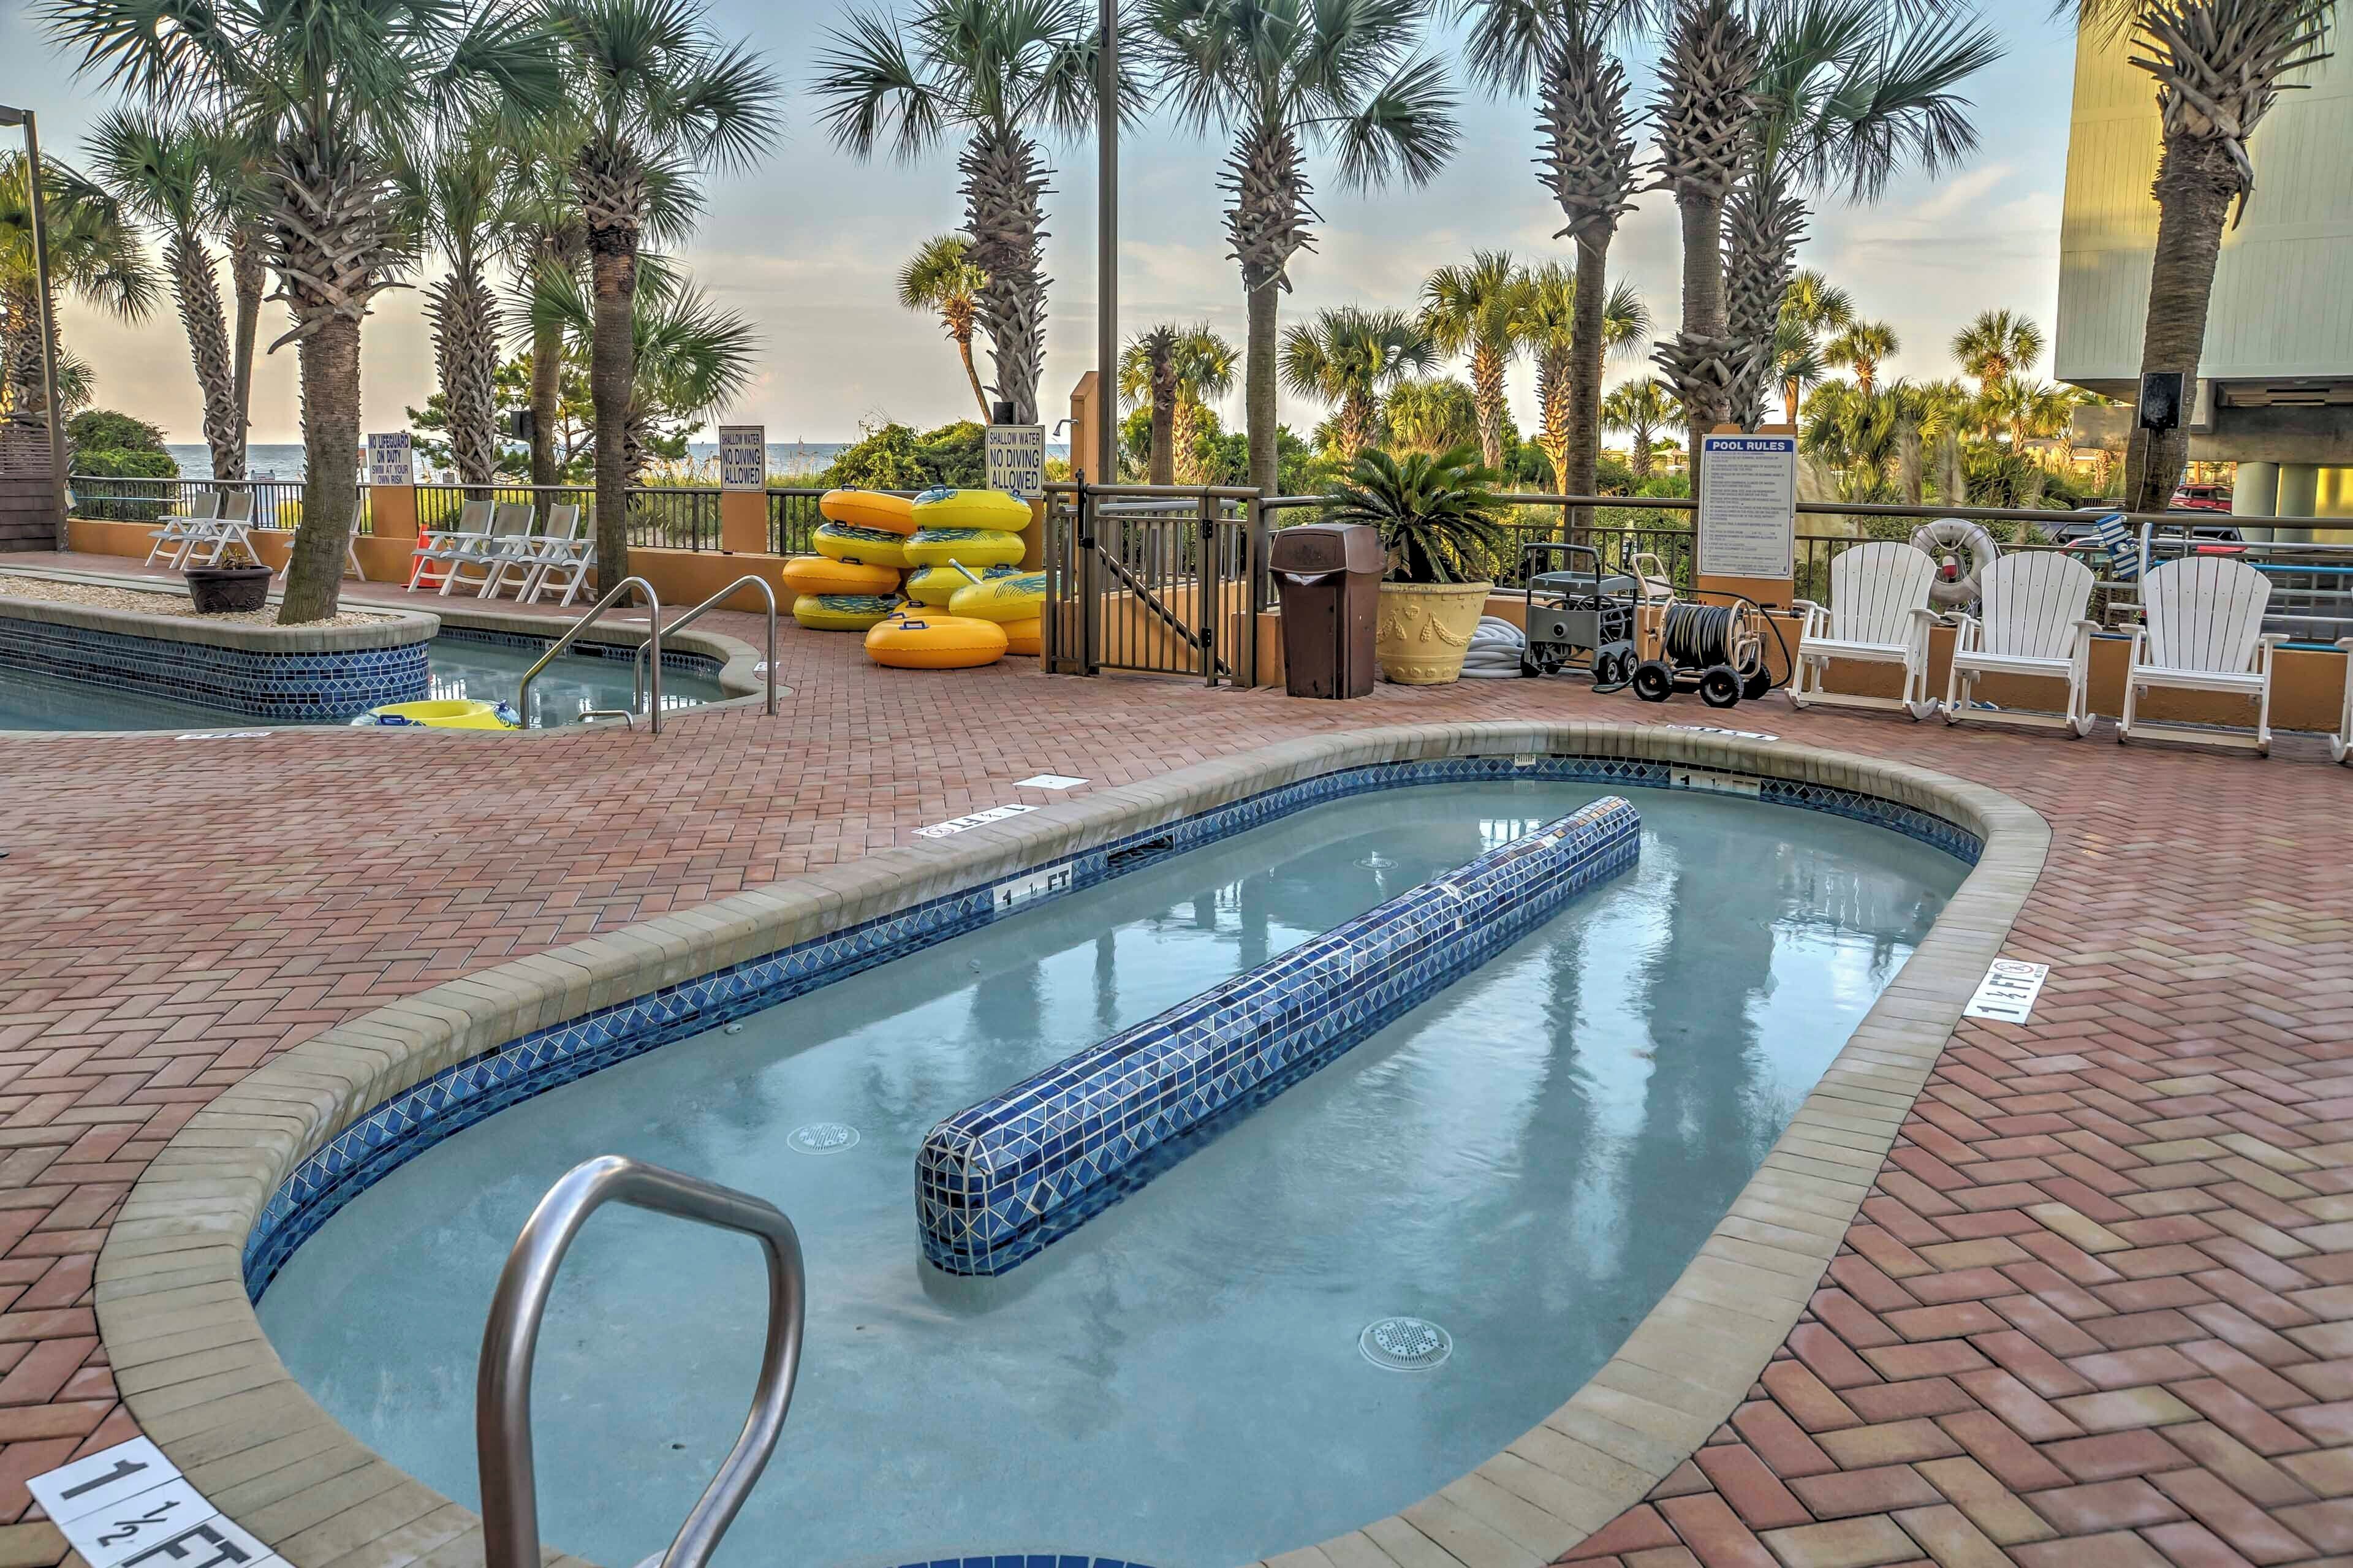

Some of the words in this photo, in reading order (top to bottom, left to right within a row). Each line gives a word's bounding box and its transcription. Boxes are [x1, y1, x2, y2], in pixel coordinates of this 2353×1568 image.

[369, 435, 377, 449] NO
[379, 434, 409, 449] LIFEGUARD
[721, 433, 743, 445] SHALLOW
[743, 434, 760, 445] WATER
[990, 432, 1017, 445] SHALLOW
[1019, 432, 1040, 445] WATER
[1713, 441, 1743, 450] POOL
[1746, 442, 1785, 450] RULES
[377, 450, 384, 463] ON
[387, 449, 401, 463] DUTY
[722, 448, 733, 465] NO
[735, 448, 760, 465] DIVING
[990, 449, 1003, 468] NO
[1007, 449, 1039, 468] DIVING
[372, 465, 384, 474] SWIM
[386, 465, 392, 474] AT
[395, 465, 408, 474] YOUR
[725, 467, 760, 484] ALLOWED
[377, 475, 389, 484] OWN
[391, 475, 403, 484] RISK
[991, 470, 1038, 490] ALLOWED
[1048, 869, 1069, 891] FT
[1989, 974, 2034, 990] FT
[60, 1458, 150, 1501] 1
